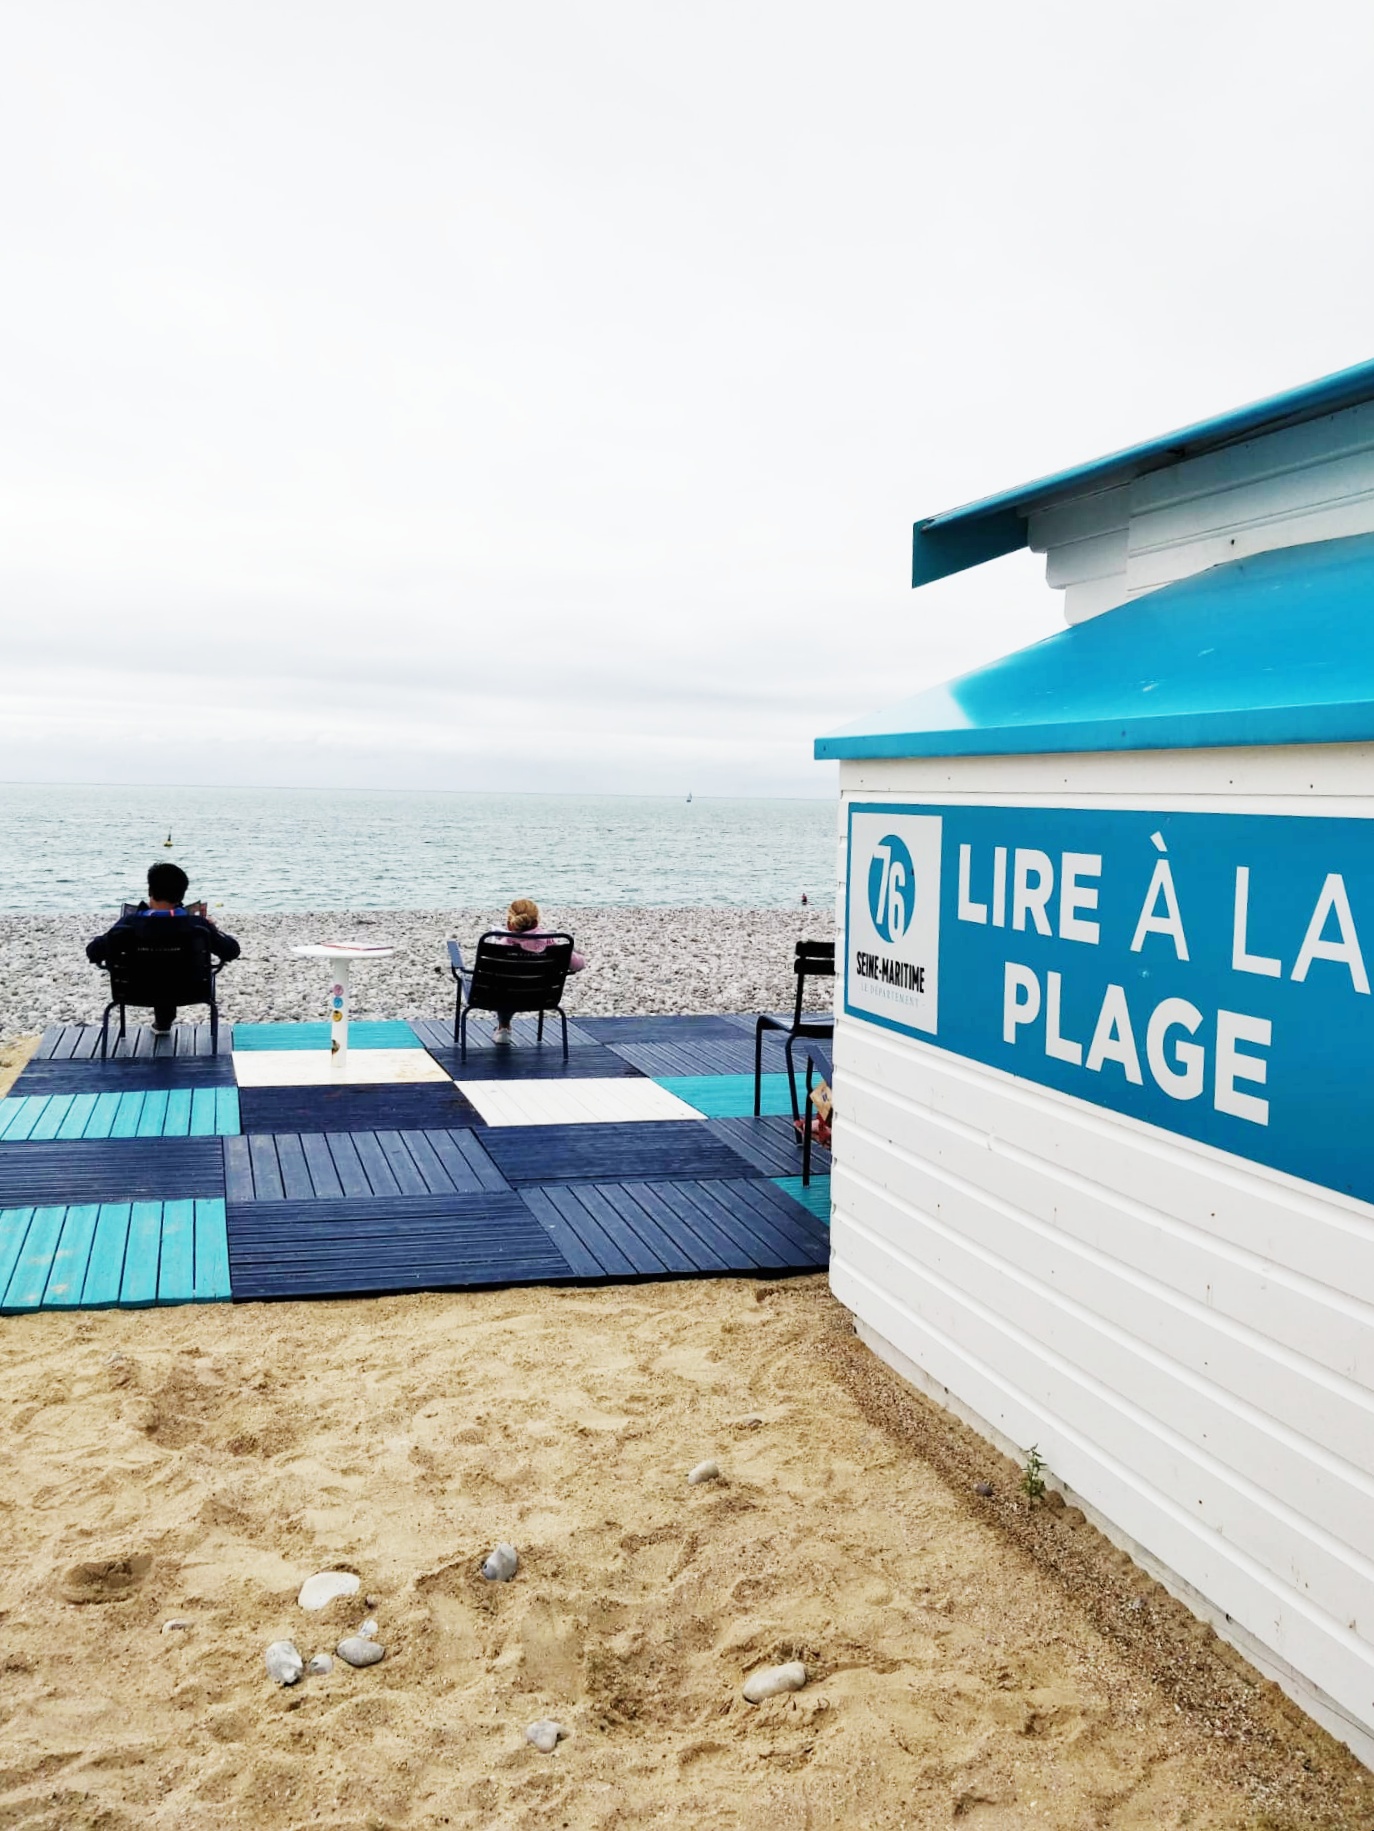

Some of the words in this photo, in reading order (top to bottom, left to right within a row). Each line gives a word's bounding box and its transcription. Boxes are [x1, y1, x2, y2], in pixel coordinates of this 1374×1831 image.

[872, 843, 906, 943] 76
[957, 843, 1102, 945] LIRE
[1130, 831, 1190, 962] À
[1231, 865, 1372, 995] LA
[856, 950, 925, 994] SEINE-MARITIME
[860, 982, 868, 993] LE
[1003, 961, 1273, 1127] PLAGE
